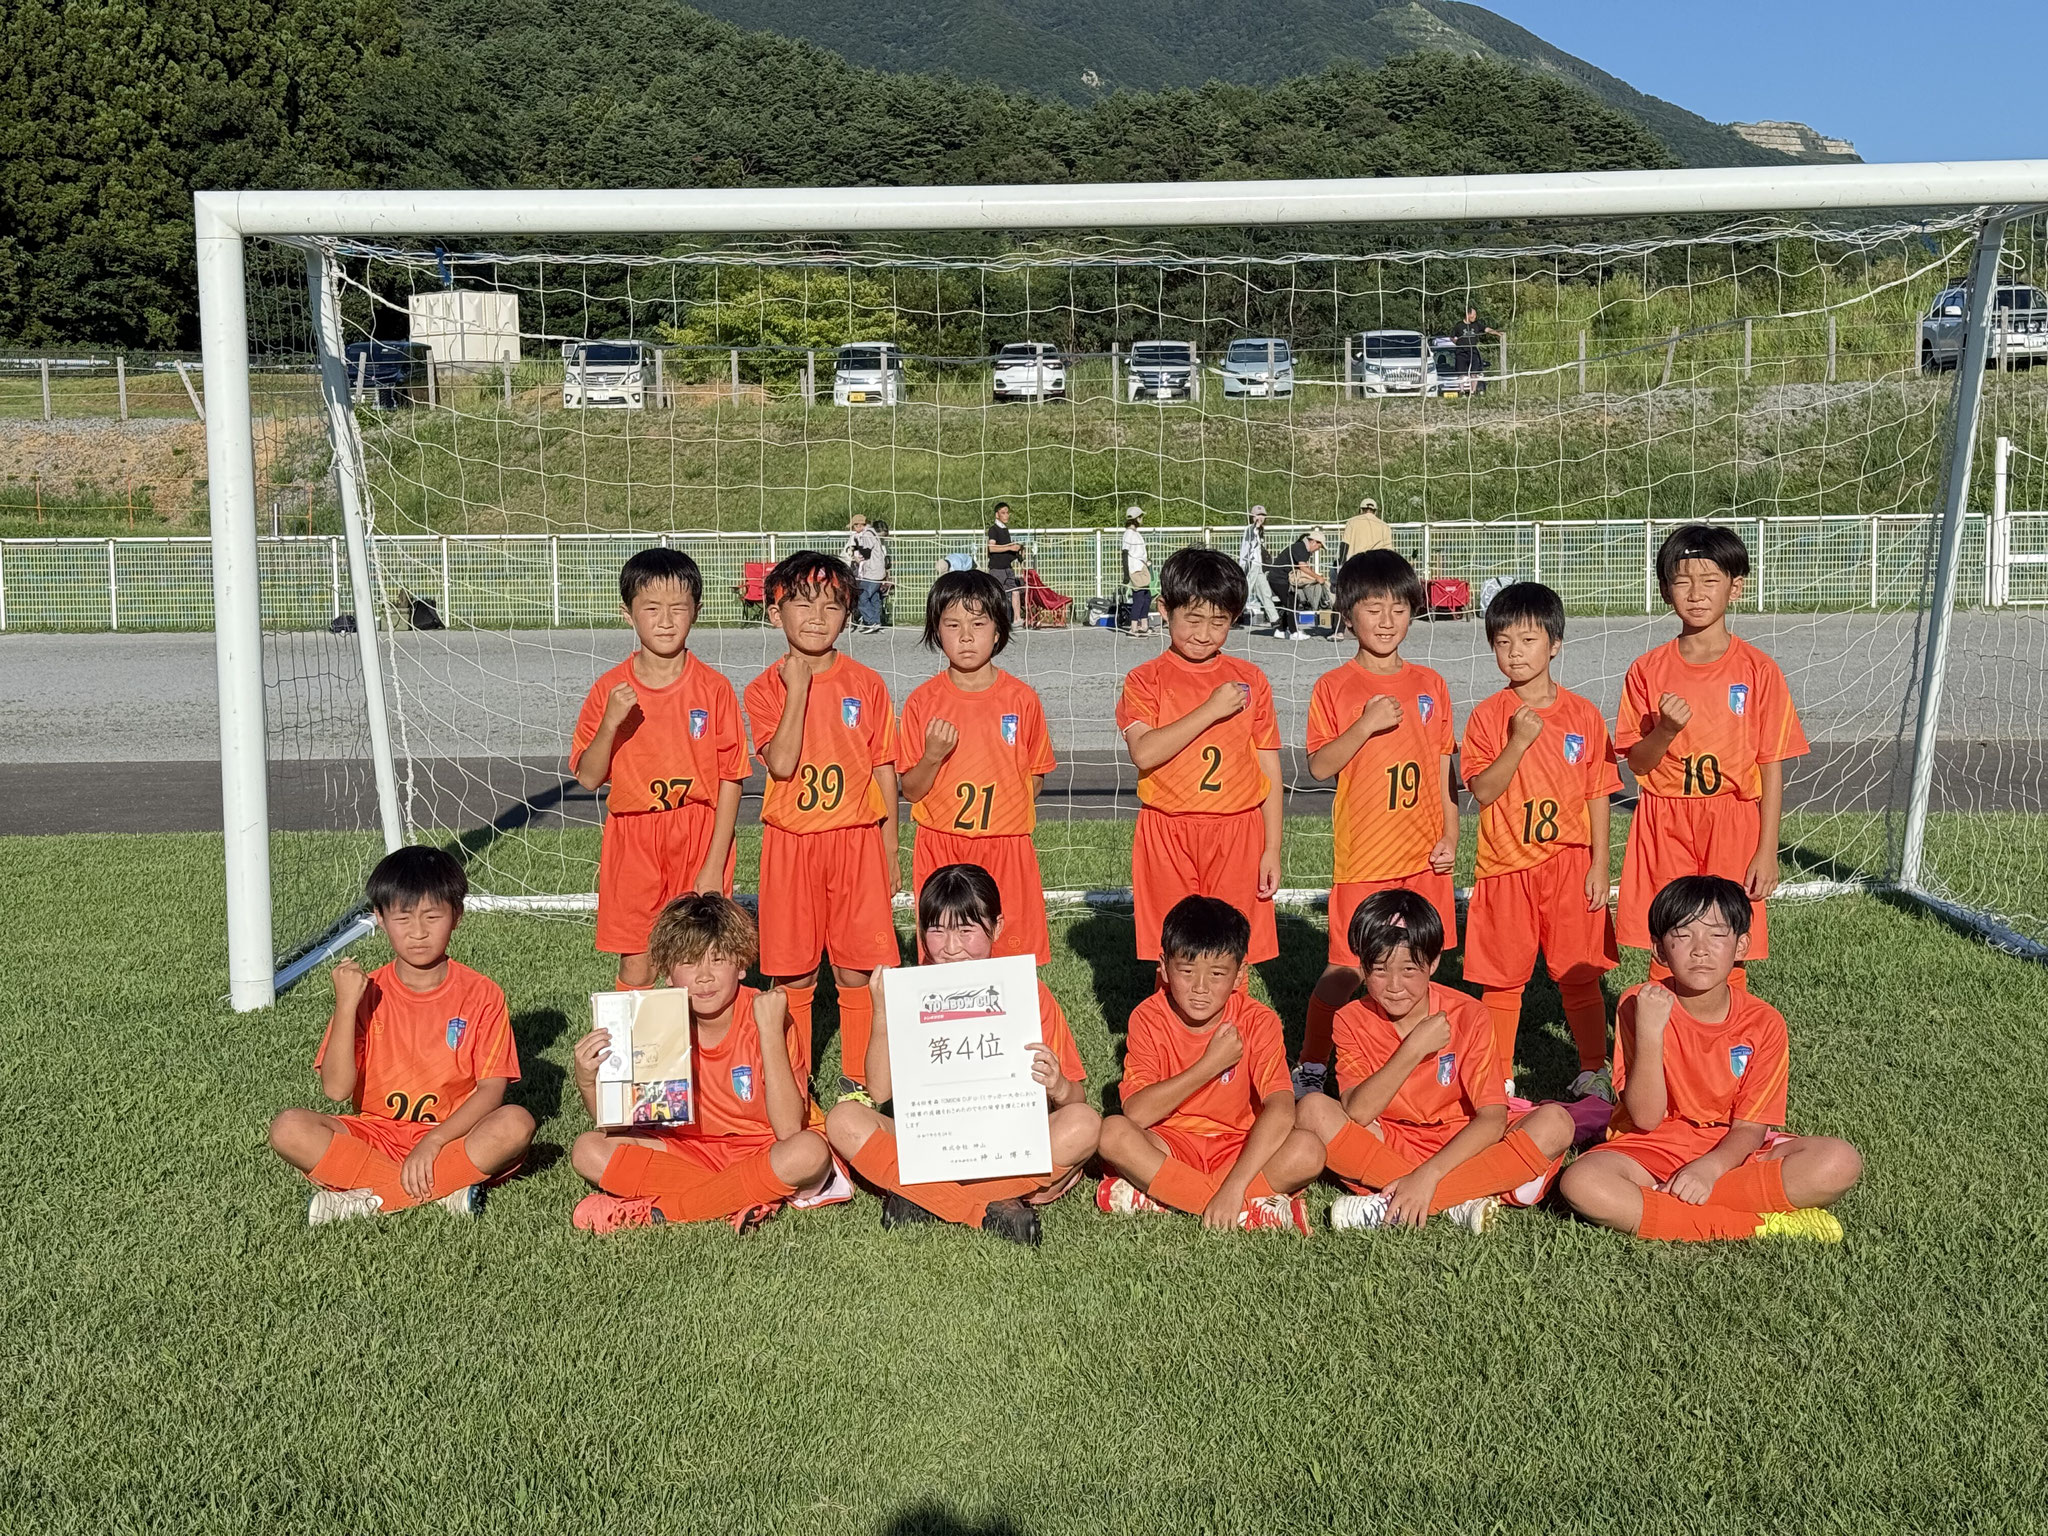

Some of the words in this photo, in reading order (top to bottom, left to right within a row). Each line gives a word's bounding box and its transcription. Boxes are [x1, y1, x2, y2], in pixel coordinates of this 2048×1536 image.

[795, 762, 845, 812] 39
[1198, 744, 1223, 793] 2
[1385, 760, 1422, 812] 19
[1680, 752, 1723, 797] 10
[649, 777, 695, 812] 37
[952, 781, 998, 831] 21
[1521, 798, 1560, 846] 18
[926, 997, 976, 1013] TOMBOW
[976, 994, 999, 1007] CUP
[928, 1032, 1004, 1065] 第4位
[384, 1090, 440, 1122] 26
